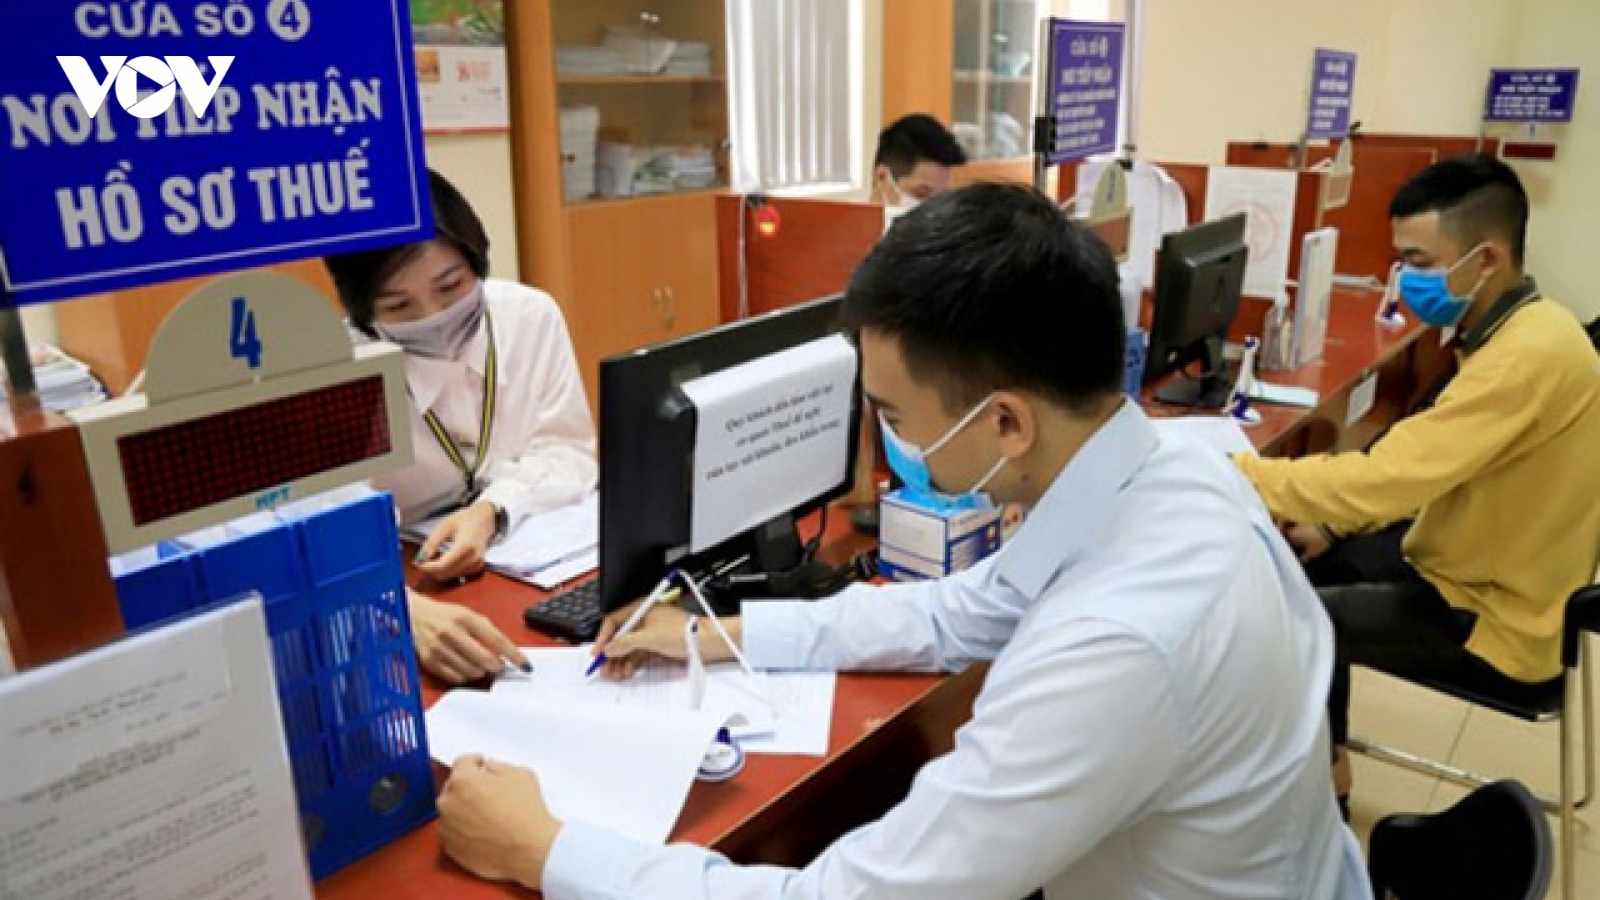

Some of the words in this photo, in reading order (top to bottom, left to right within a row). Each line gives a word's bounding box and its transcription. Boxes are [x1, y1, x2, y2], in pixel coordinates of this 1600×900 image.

[252, 66, 382, 135] NHẬN
[56, 160, 144, 250] HỒ
[160, 167, 236, 235] SƠ
[247, 138, 375, 223] THUẾ
[230, 296, 263, 369] 4
